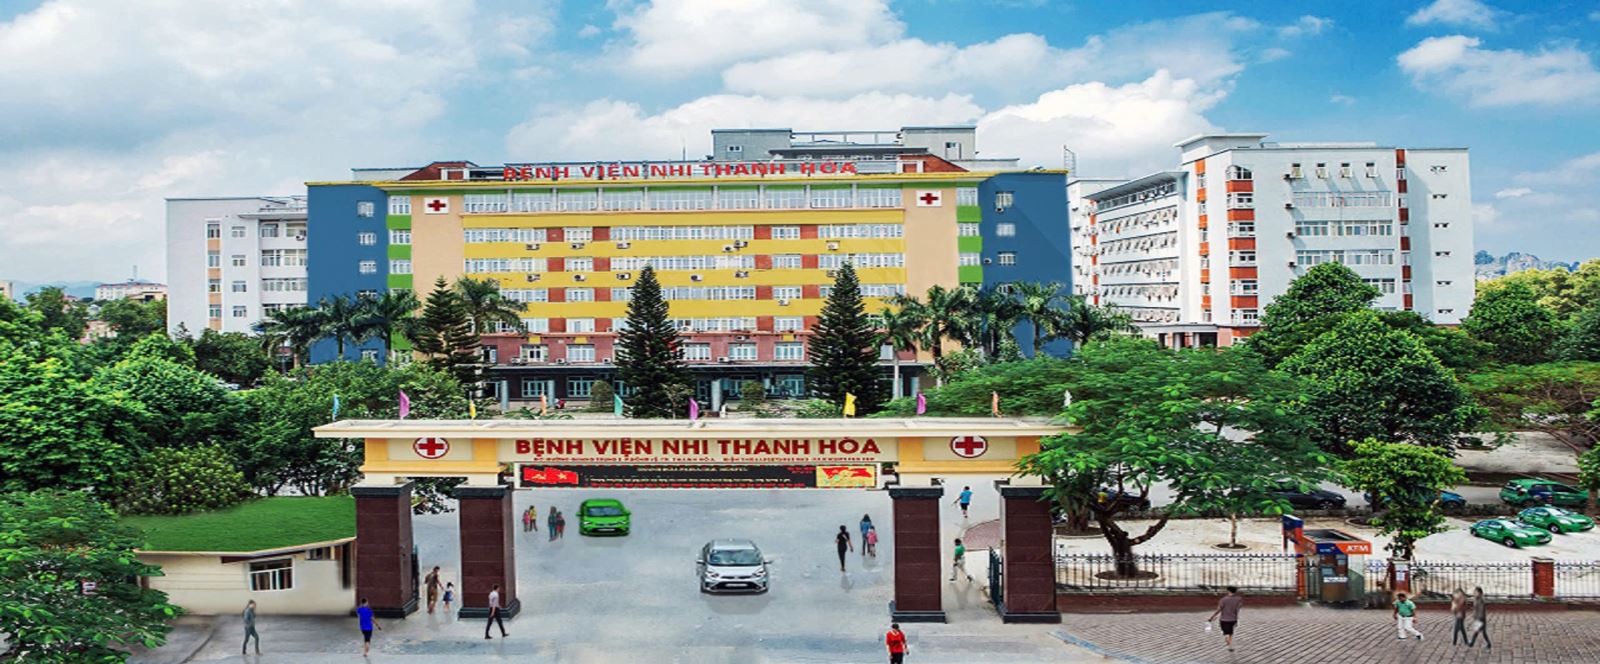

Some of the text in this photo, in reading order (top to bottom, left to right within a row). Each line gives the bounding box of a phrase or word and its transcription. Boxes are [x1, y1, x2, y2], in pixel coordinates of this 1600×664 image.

[580, 164, 639, 180] VIỆN
[650, 164, 692, 177] NHI
[700, 163, 785, 176] THANH
[515, 438, 583, 457] BỆNH
[592, 437, 652, 457] VIỆN
[662, 439, 709, 455] NHI
[717, 439, 811, 455] THANH
